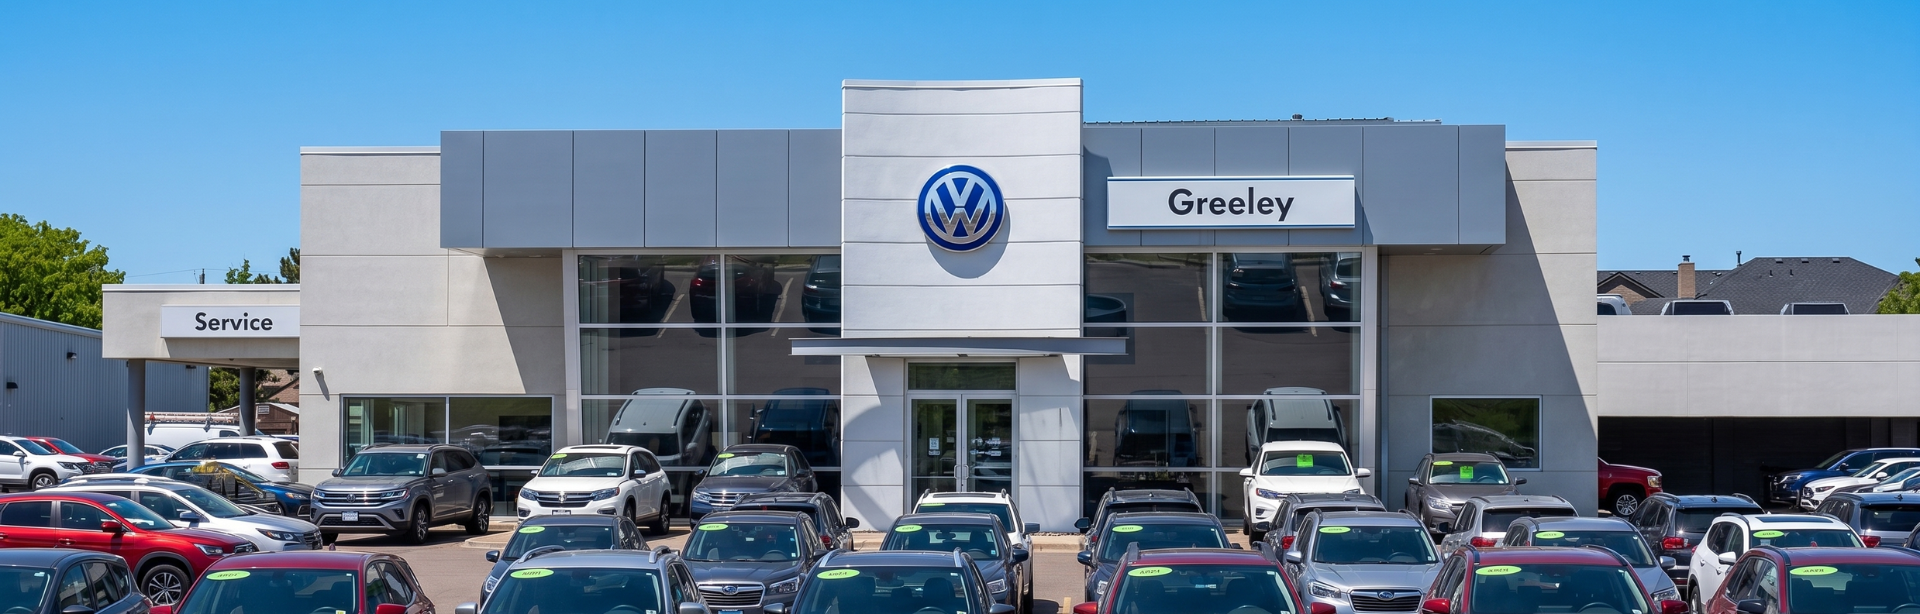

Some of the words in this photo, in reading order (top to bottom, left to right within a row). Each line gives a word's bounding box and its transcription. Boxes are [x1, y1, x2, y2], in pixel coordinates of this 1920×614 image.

[923, 169, 998, 246] VW
[1168, 186, 1295, 222] Greeley
[195, 312, 273, 331] Service
